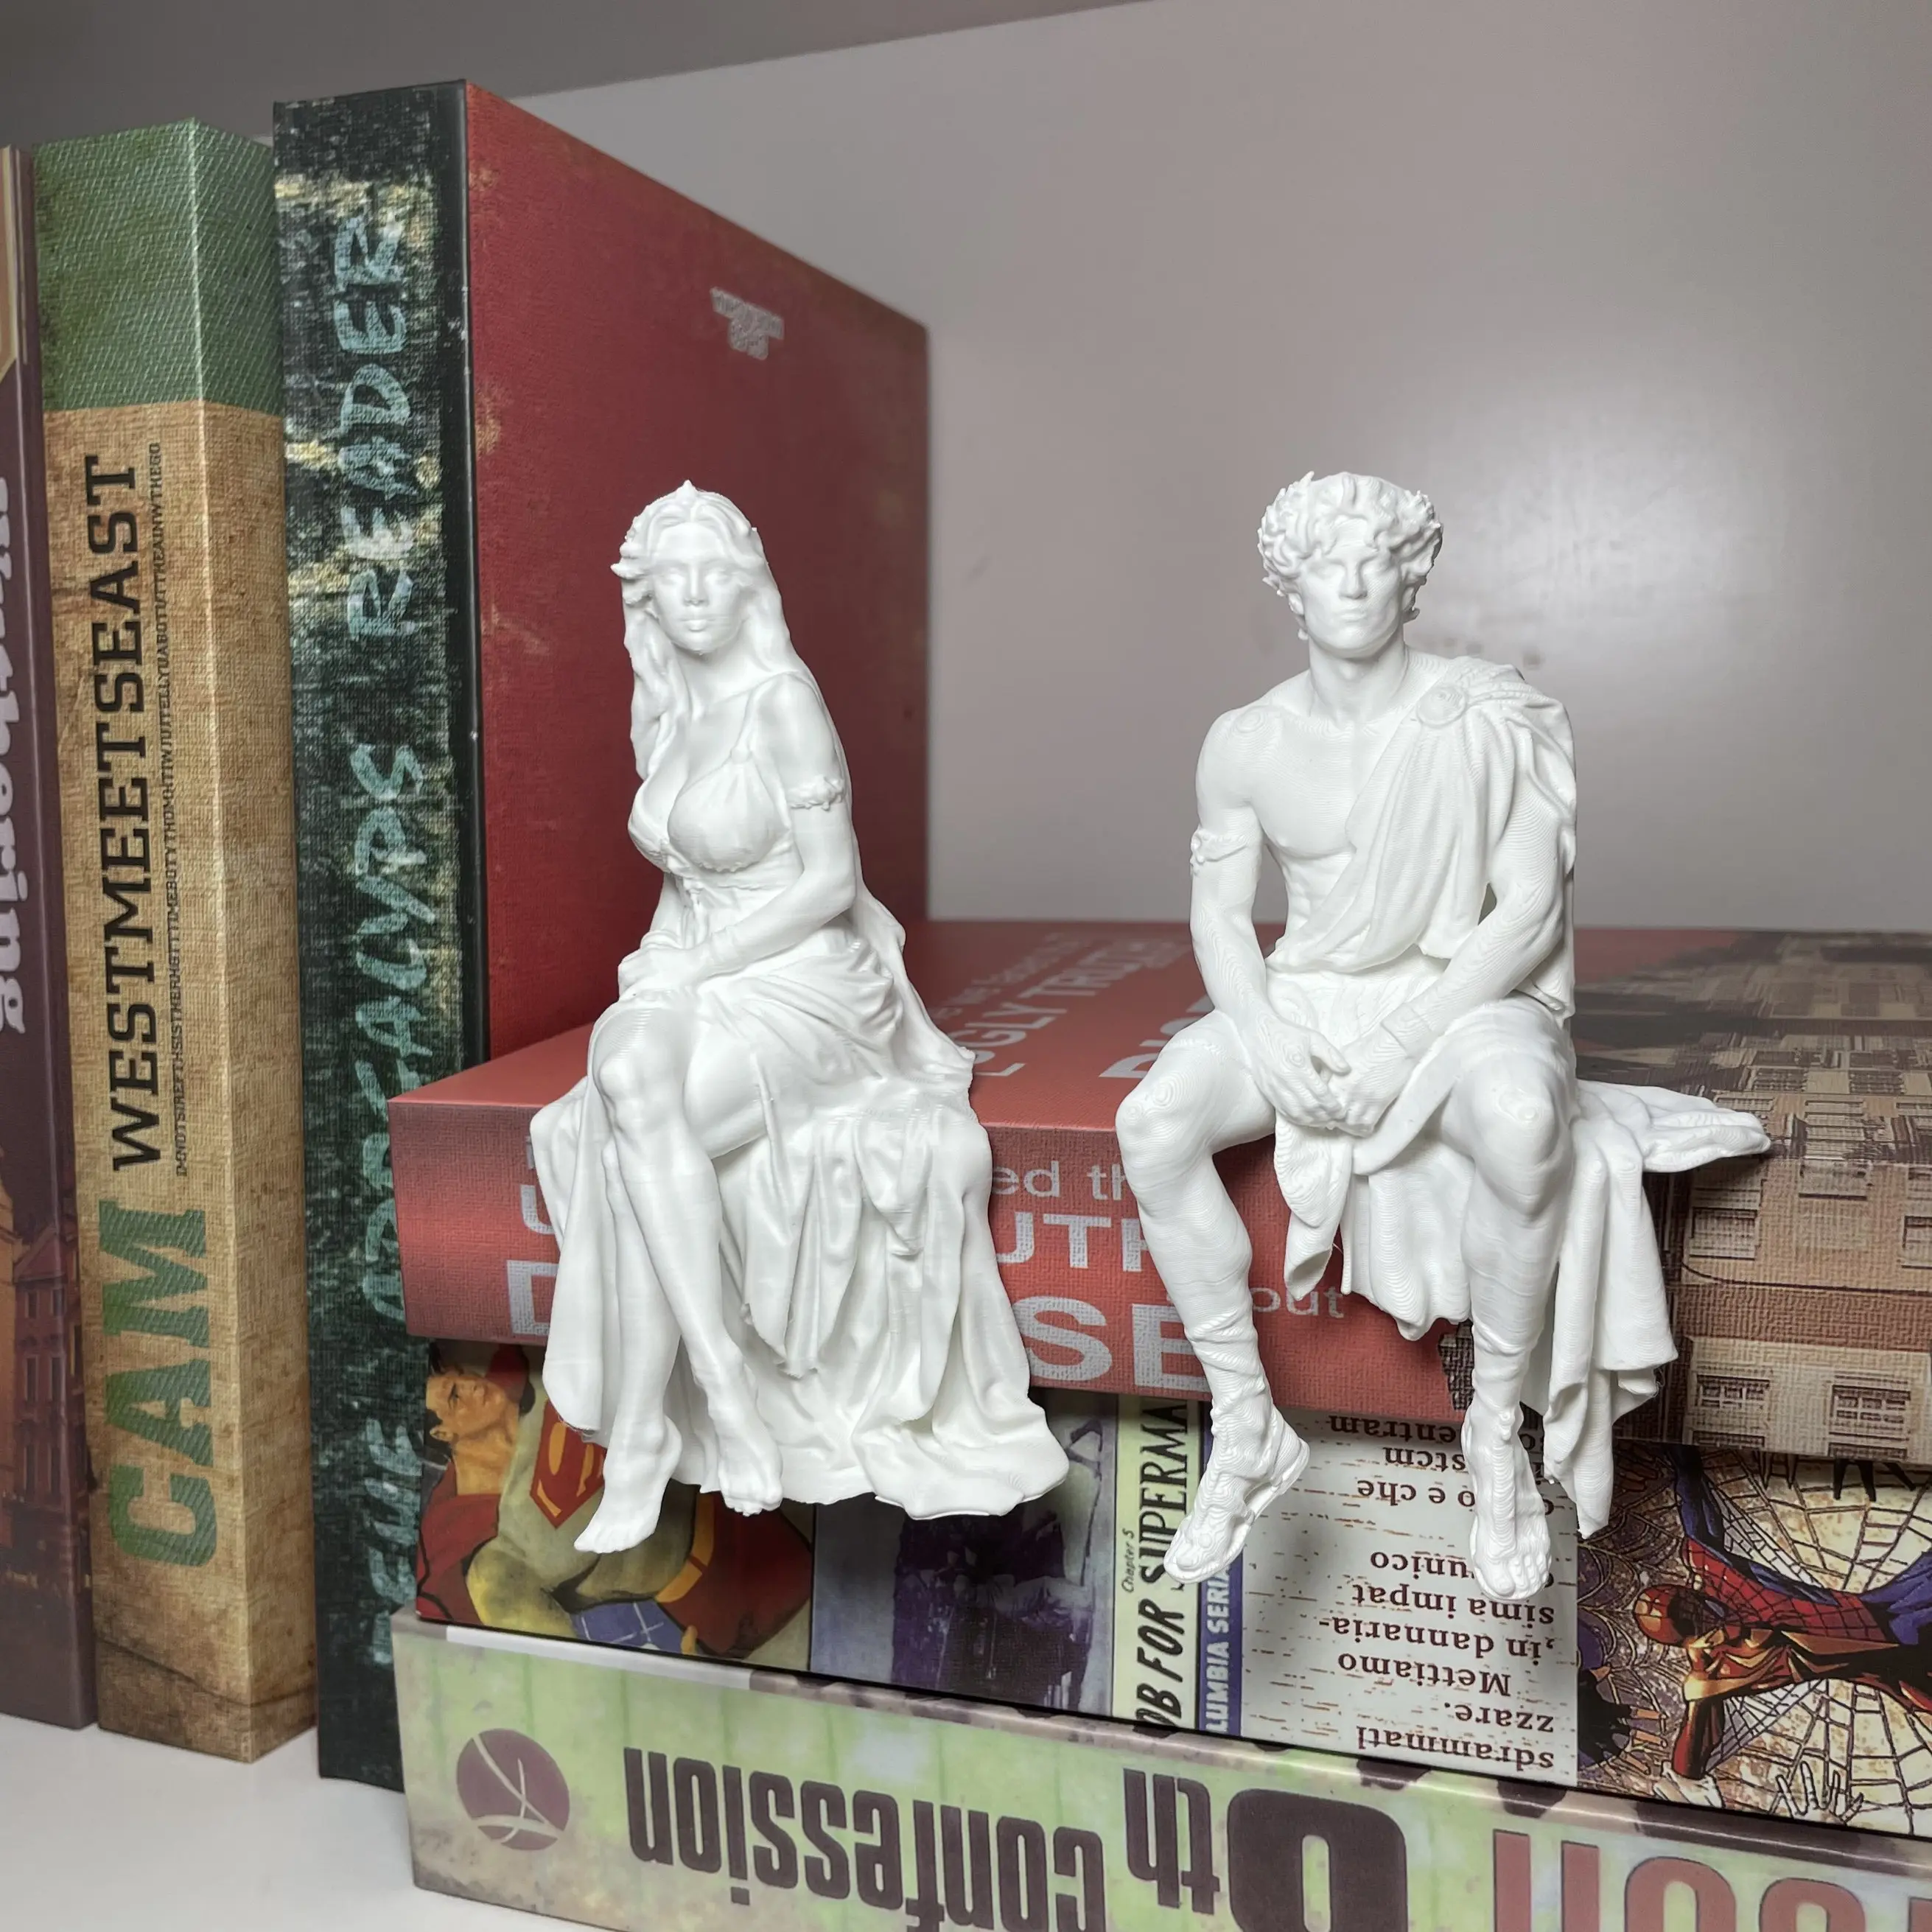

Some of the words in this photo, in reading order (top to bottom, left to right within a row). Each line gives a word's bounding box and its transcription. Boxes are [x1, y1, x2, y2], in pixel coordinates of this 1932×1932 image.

[334, 215, 418, 640] READER
[85, 455, 161, 1171] WESTMEETSEAST
[99, 1200, 217, 1567] CAM
[1357, 1479, 1417, 1507] che
[1121, 1539, 1135, 1593] Chapter
[1351, 1583, 1457, 1619] impat
[1467, 1597, 1555, 1629] sima
[1136, 1598, 1186, 1683] FOR
[1319, 1617, 1494, 1659] dannaria-
[1337, 1653, 1511, 1697] Mettiamo
[1444, 1702, 1555, 1733] zzare.
[624, 1746, 1107, 1932] confession
